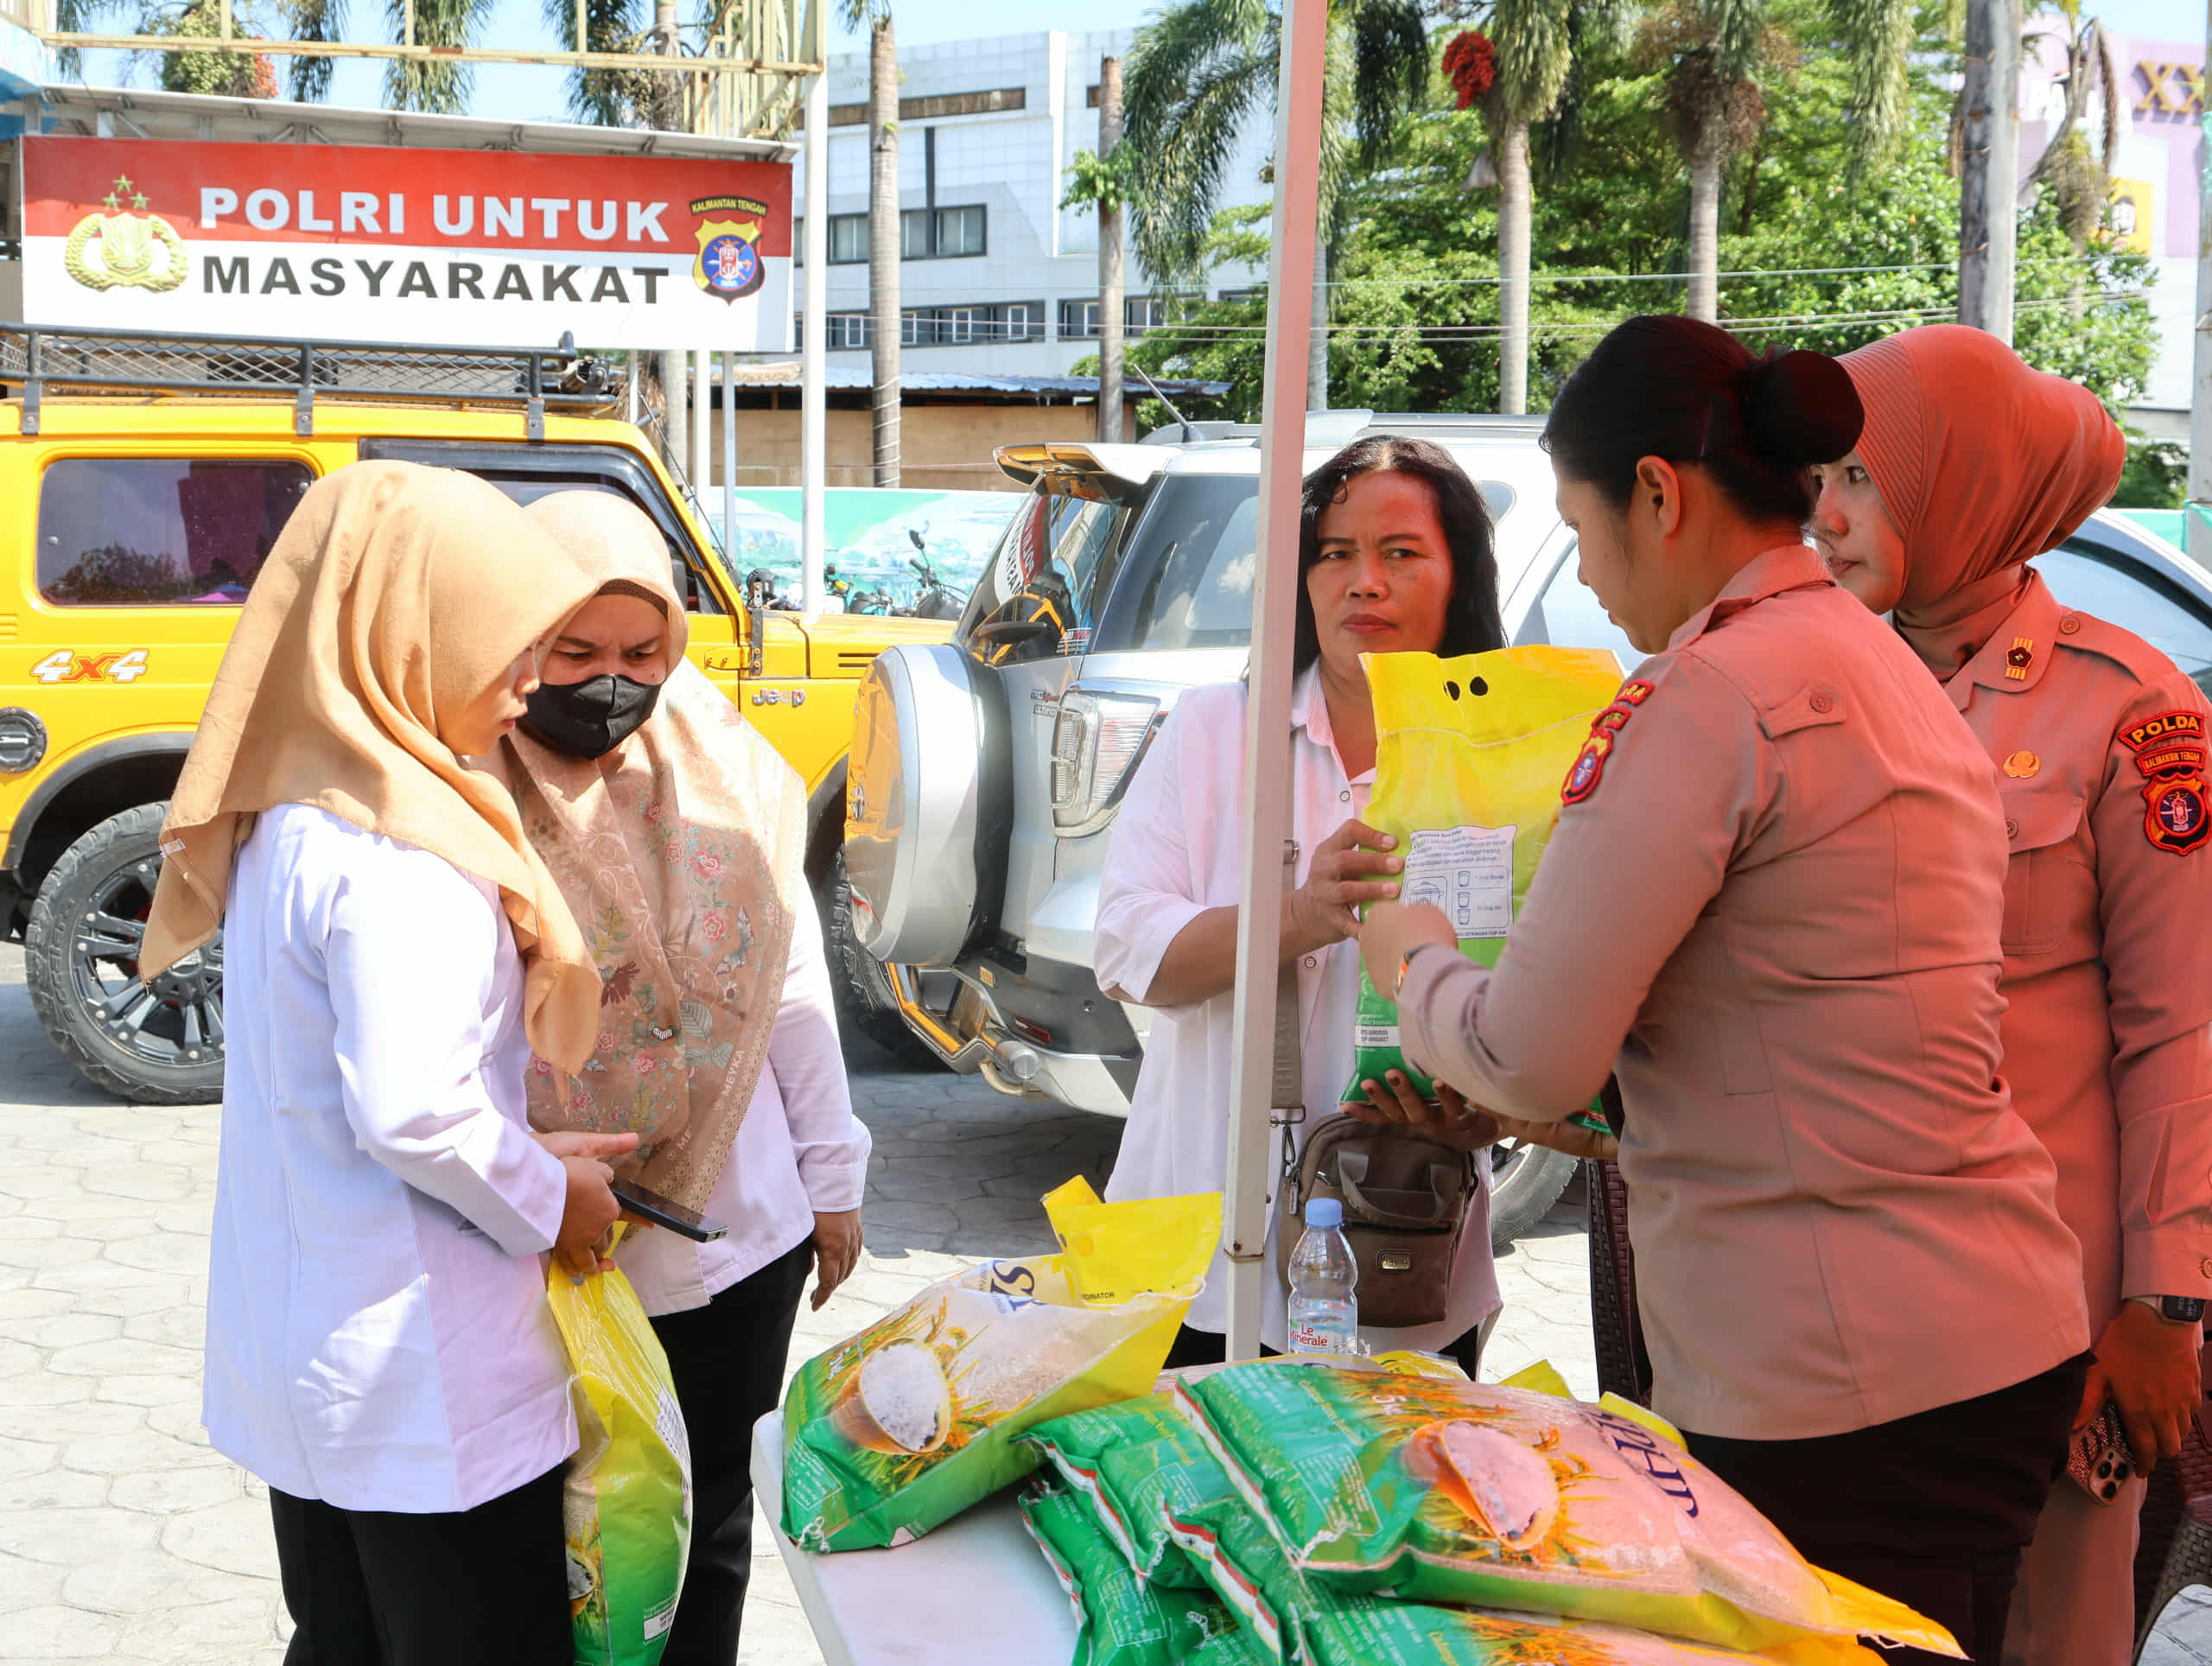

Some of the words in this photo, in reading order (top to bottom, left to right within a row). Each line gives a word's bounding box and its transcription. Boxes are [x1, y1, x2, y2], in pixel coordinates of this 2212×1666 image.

[200, 187, 405, 234] POLRI
[433, 195, 671, 243] UNTUK
[692, 198, 736, 214] KALIMANTAN
[738, 198, 767, 214] TENGAH
[202, 255, 671, 304] MASYARAKAT
[753, 688, 805, 707] Jeep
[2131, 715, 2200, 743] POLDA
[2145, 752, 2180, 770] KALIMANTAN
[2180, 751, 2200, 762] TENGAH
[1301, 1323, 1314, 1336] Le
